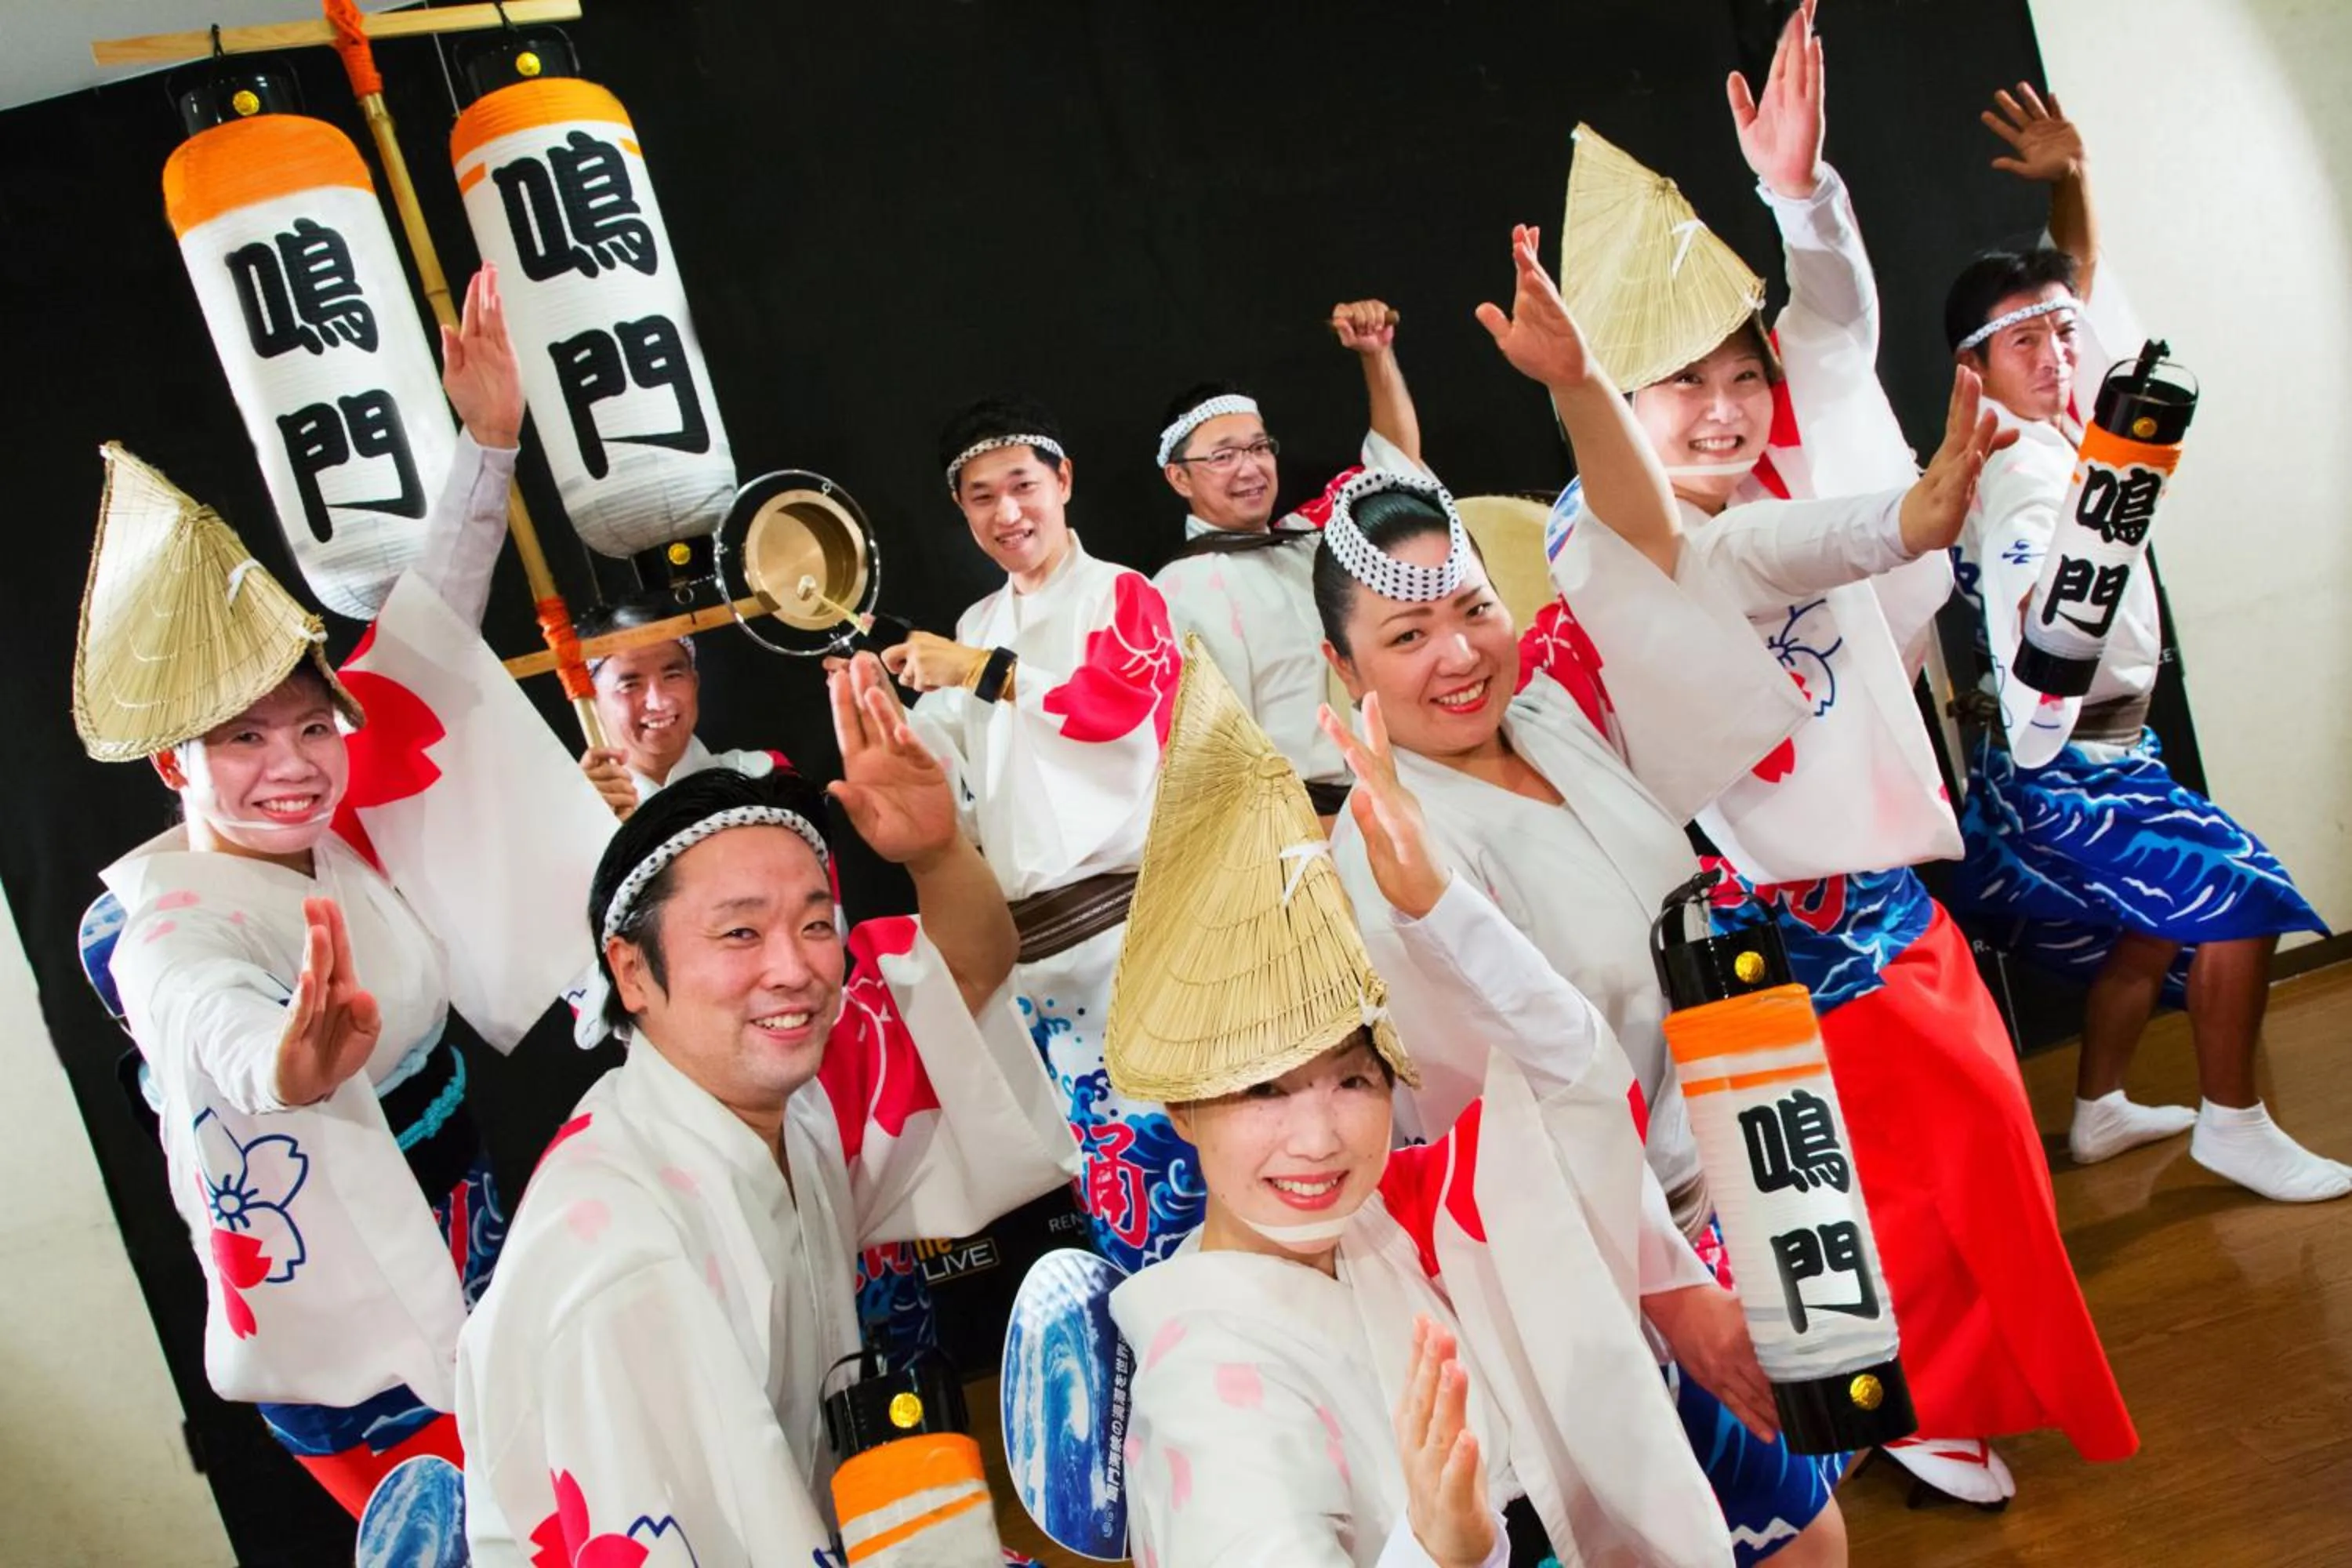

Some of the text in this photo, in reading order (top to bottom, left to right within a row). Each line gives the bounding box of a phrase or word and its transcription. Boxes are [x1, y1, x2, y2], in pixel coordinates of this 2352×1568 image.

[224, 218, 427, 543] 鳴門
[492, 130, 710, 481] 鳴門
[2041, 464, 2161, 638] 鳴門
[922, 1243, 993, 1281] LIVE
[1737, 1088, 1881, 1334] 鳴門
